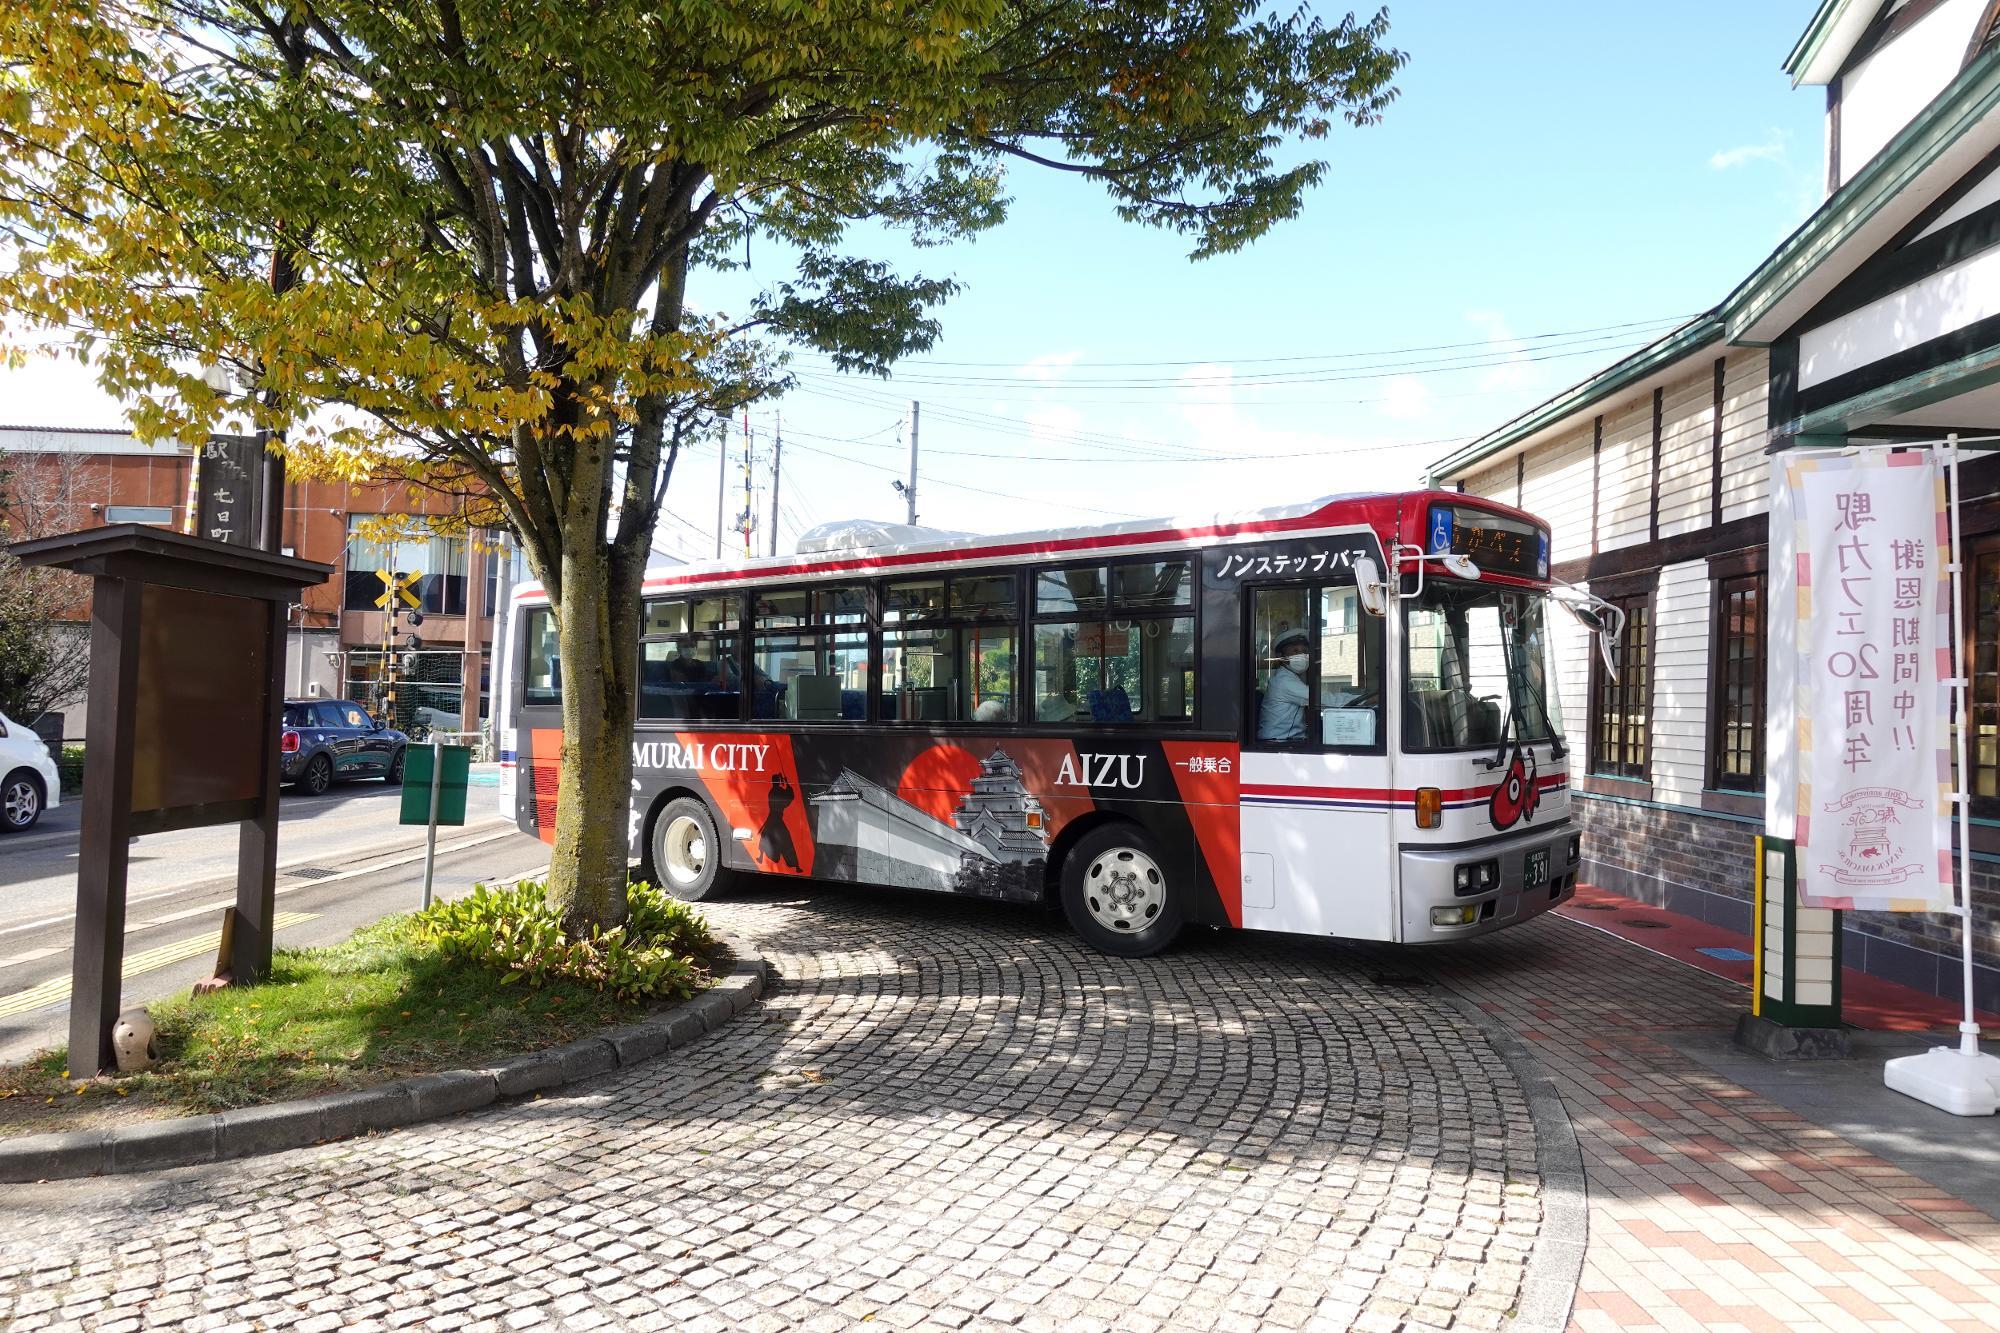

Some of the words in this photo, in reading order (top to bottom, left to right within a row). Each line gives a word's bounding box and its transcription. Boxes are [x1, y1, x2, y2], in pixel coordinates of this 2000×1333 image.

[632, 741, 704, 769] MURAI
[710, 743, 770, 772] CITY
[1053, 752, 1148, 789] AIZU
[1175, 756, 1232, 774] 一般乗合
